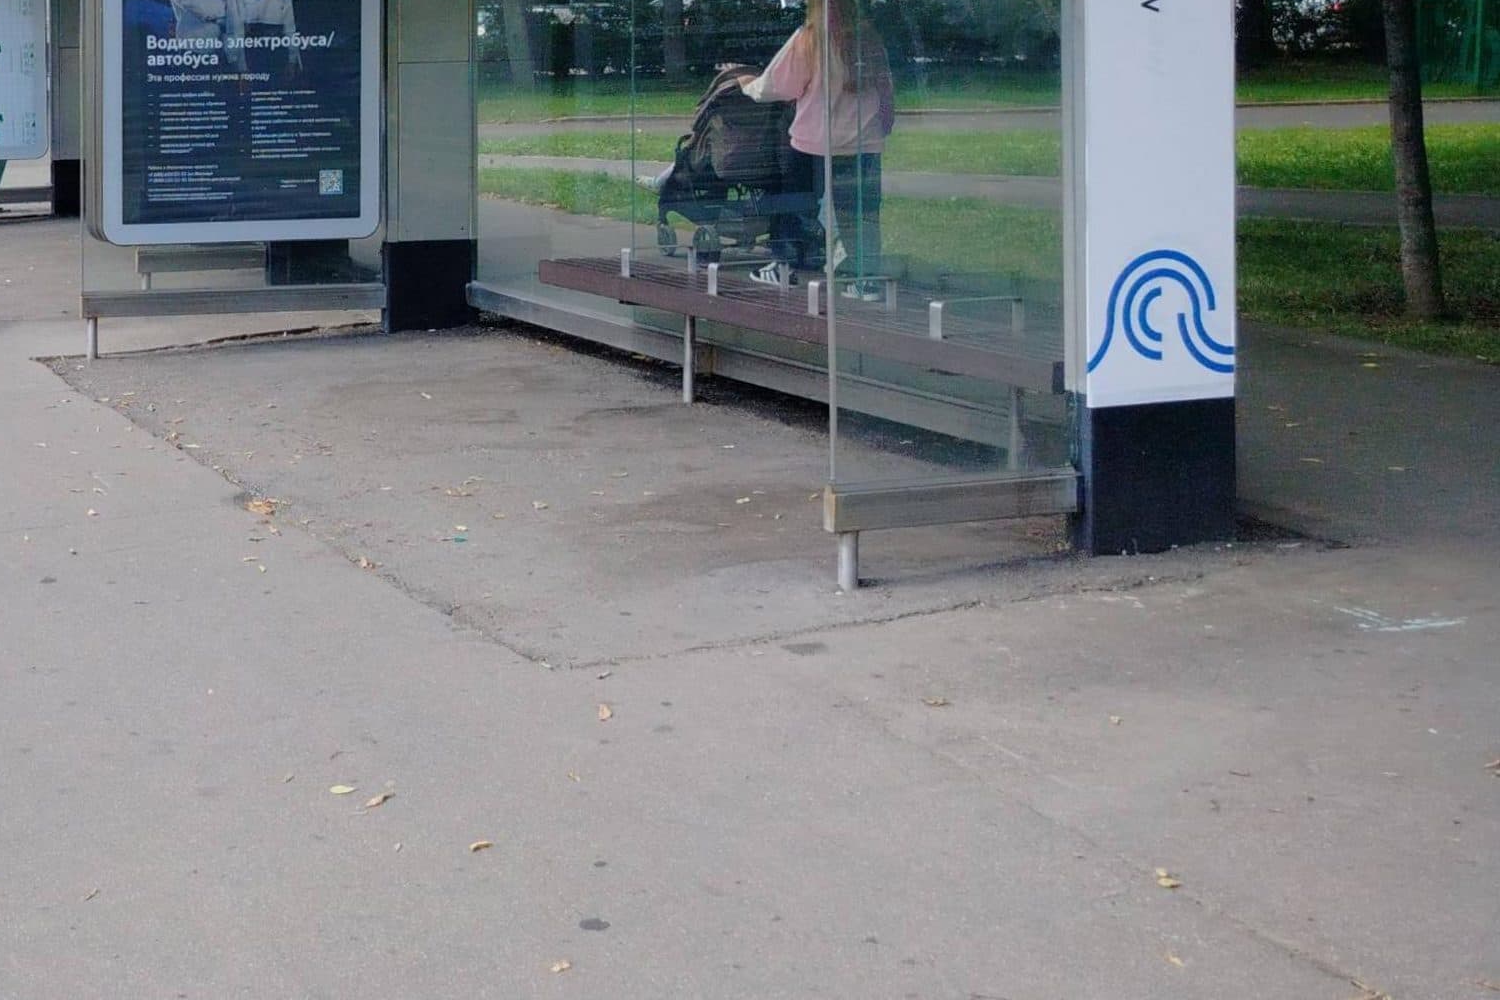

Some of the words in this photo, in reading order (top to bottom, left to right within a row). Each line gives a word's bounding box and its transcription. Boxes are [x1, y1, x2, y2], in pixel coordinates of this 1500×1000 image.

[146, 34, 223, 51] Водитель
[227, 31, 336, 51] электробуса/
[147, 50, 219, 69] автобуса
[147, 73, 162, 82] Эта
[164, 72, 211, 84] профессия
[212, 73, 239, 83] нужна
[241, 71, 271, 82] городу
